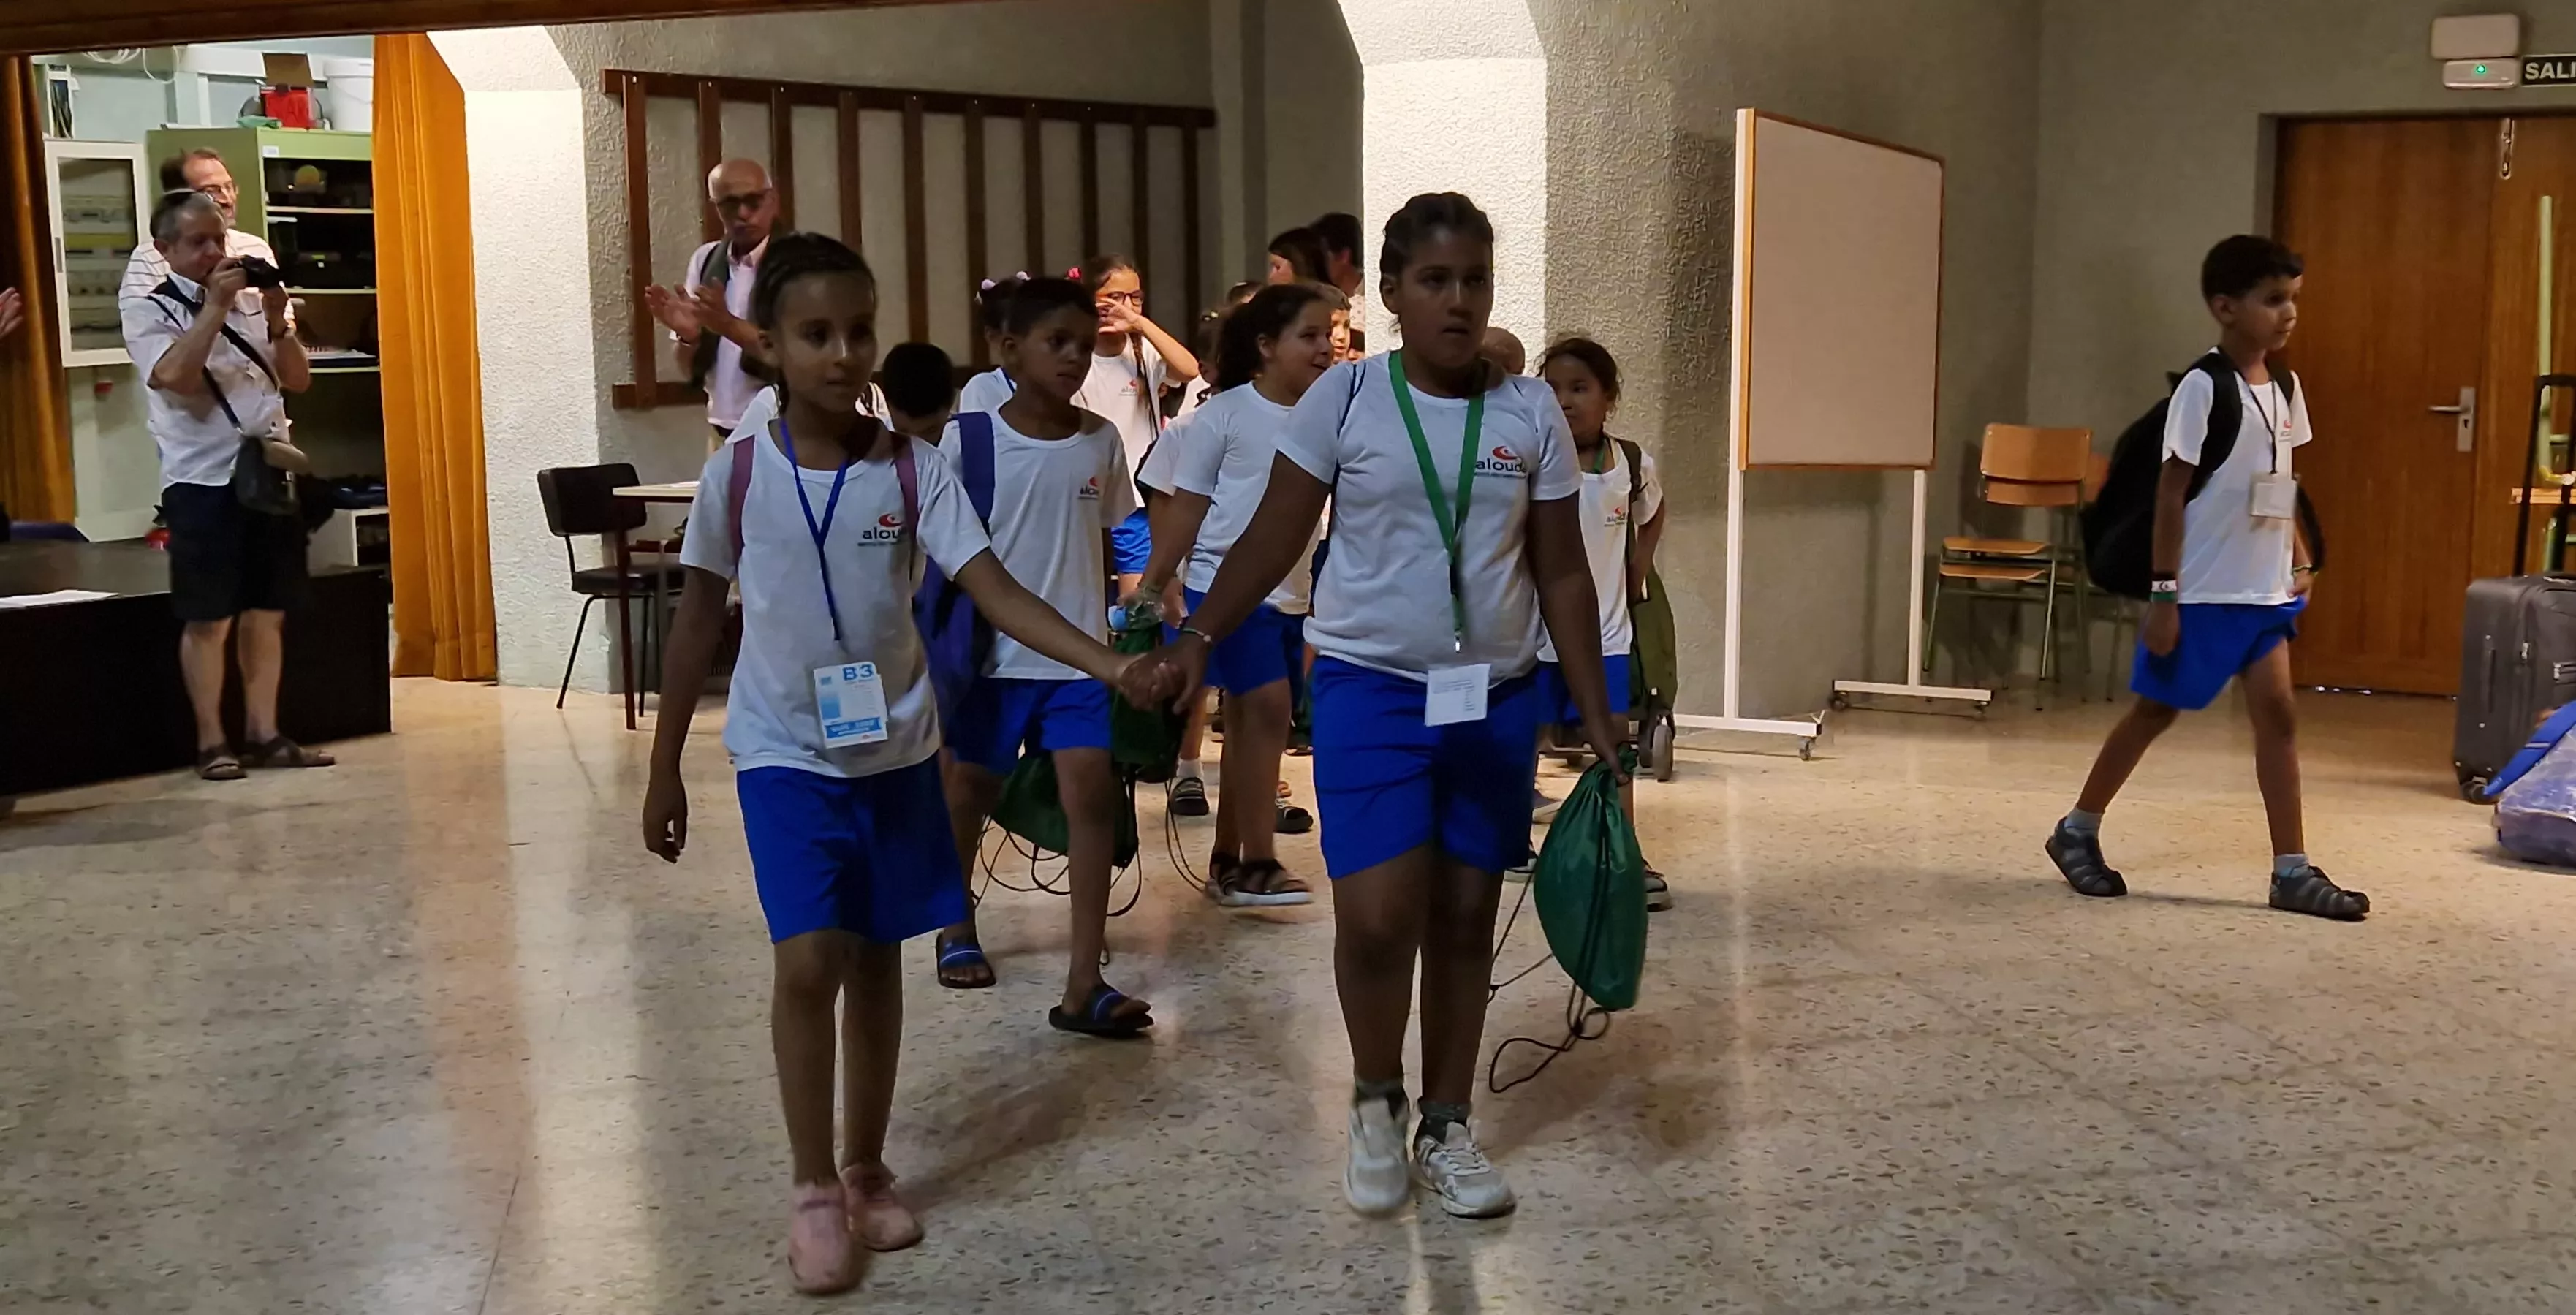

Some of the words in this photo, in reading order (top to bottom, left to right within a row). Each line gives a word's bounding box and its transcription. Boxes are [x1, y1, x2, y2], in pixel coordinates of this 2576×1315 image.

[2525, 61, 2576, 80] SALI
[862, 526, 901, 540] alou
[843, 664, 874, 681] B3
